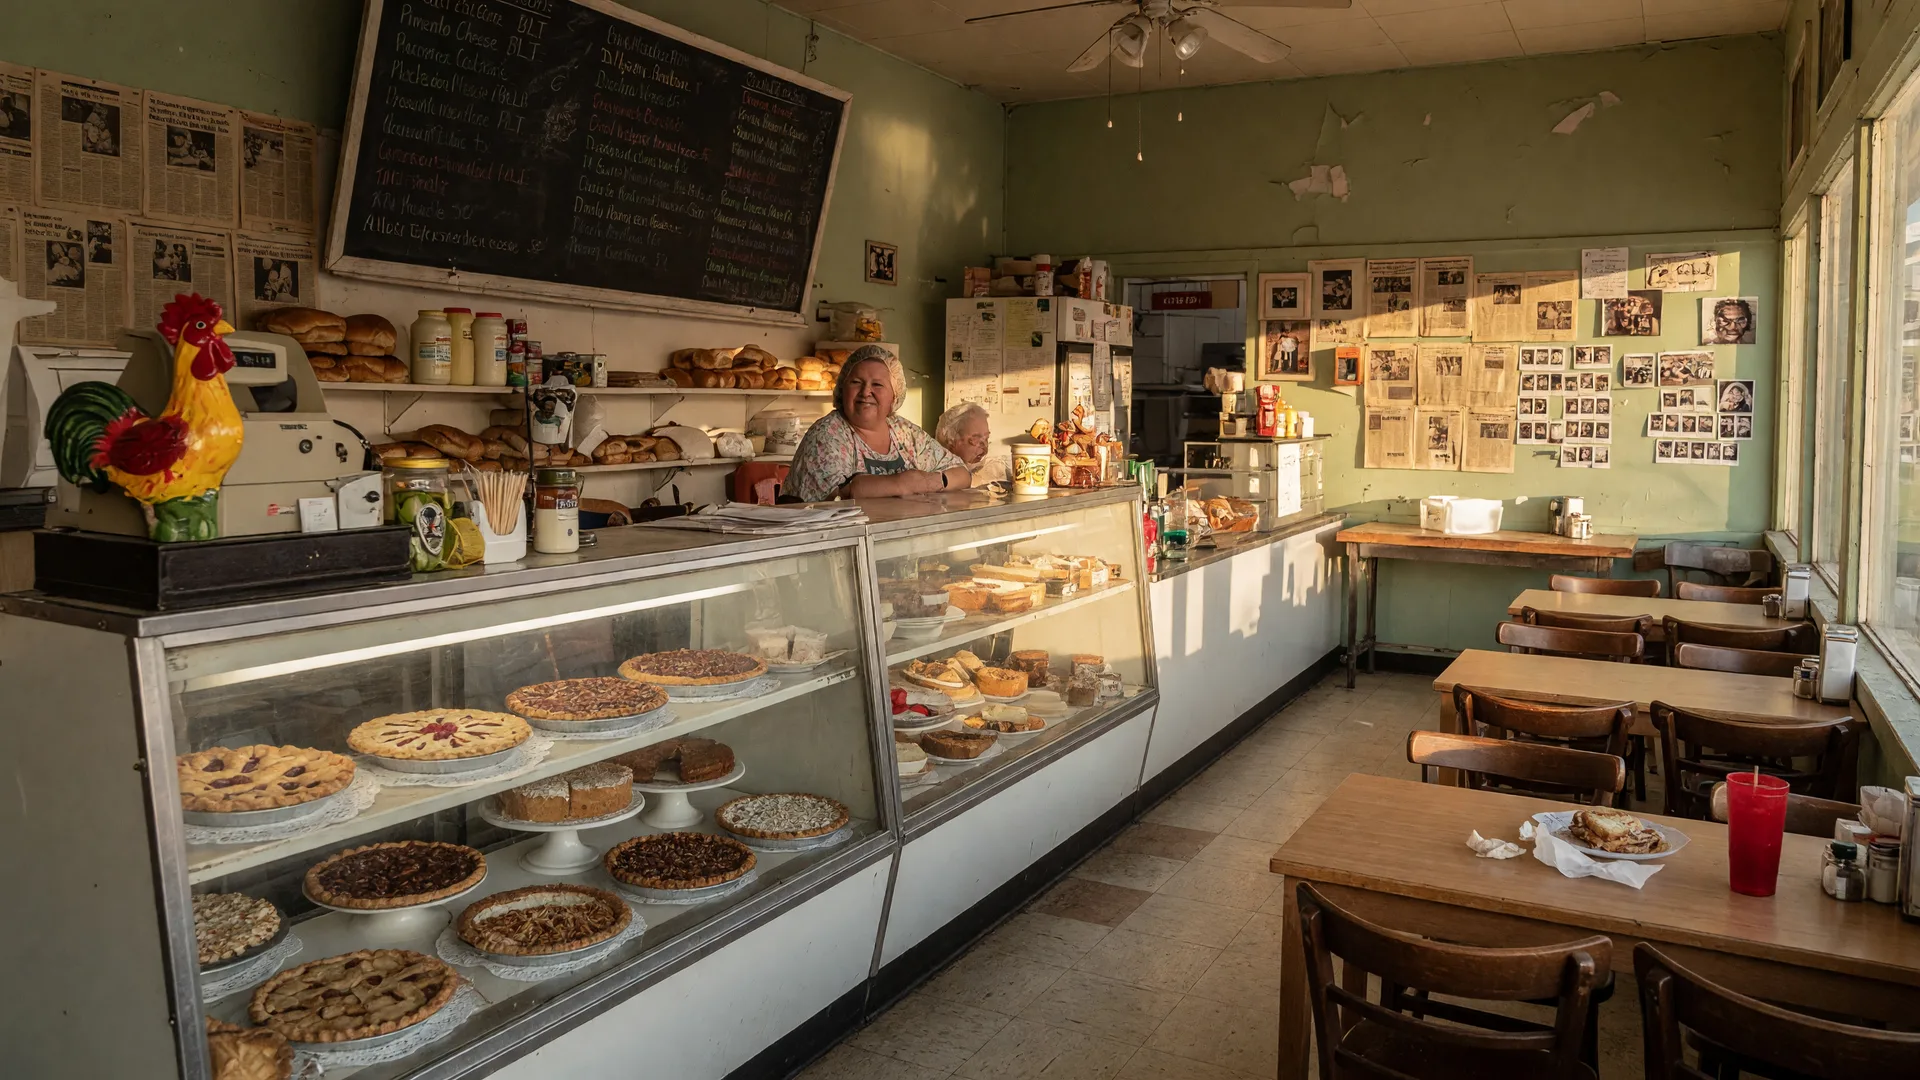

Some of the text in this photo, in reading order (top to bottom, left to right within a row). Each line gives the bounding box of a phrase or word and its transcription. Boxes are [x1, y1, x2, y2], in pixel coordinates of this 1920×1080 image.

[400, 3, 451, 37] Pimento
[455, 20, 499, 51] Cheese
[506, 35, 541, 61] BLT
[517, 14, 547, 39] BLT
